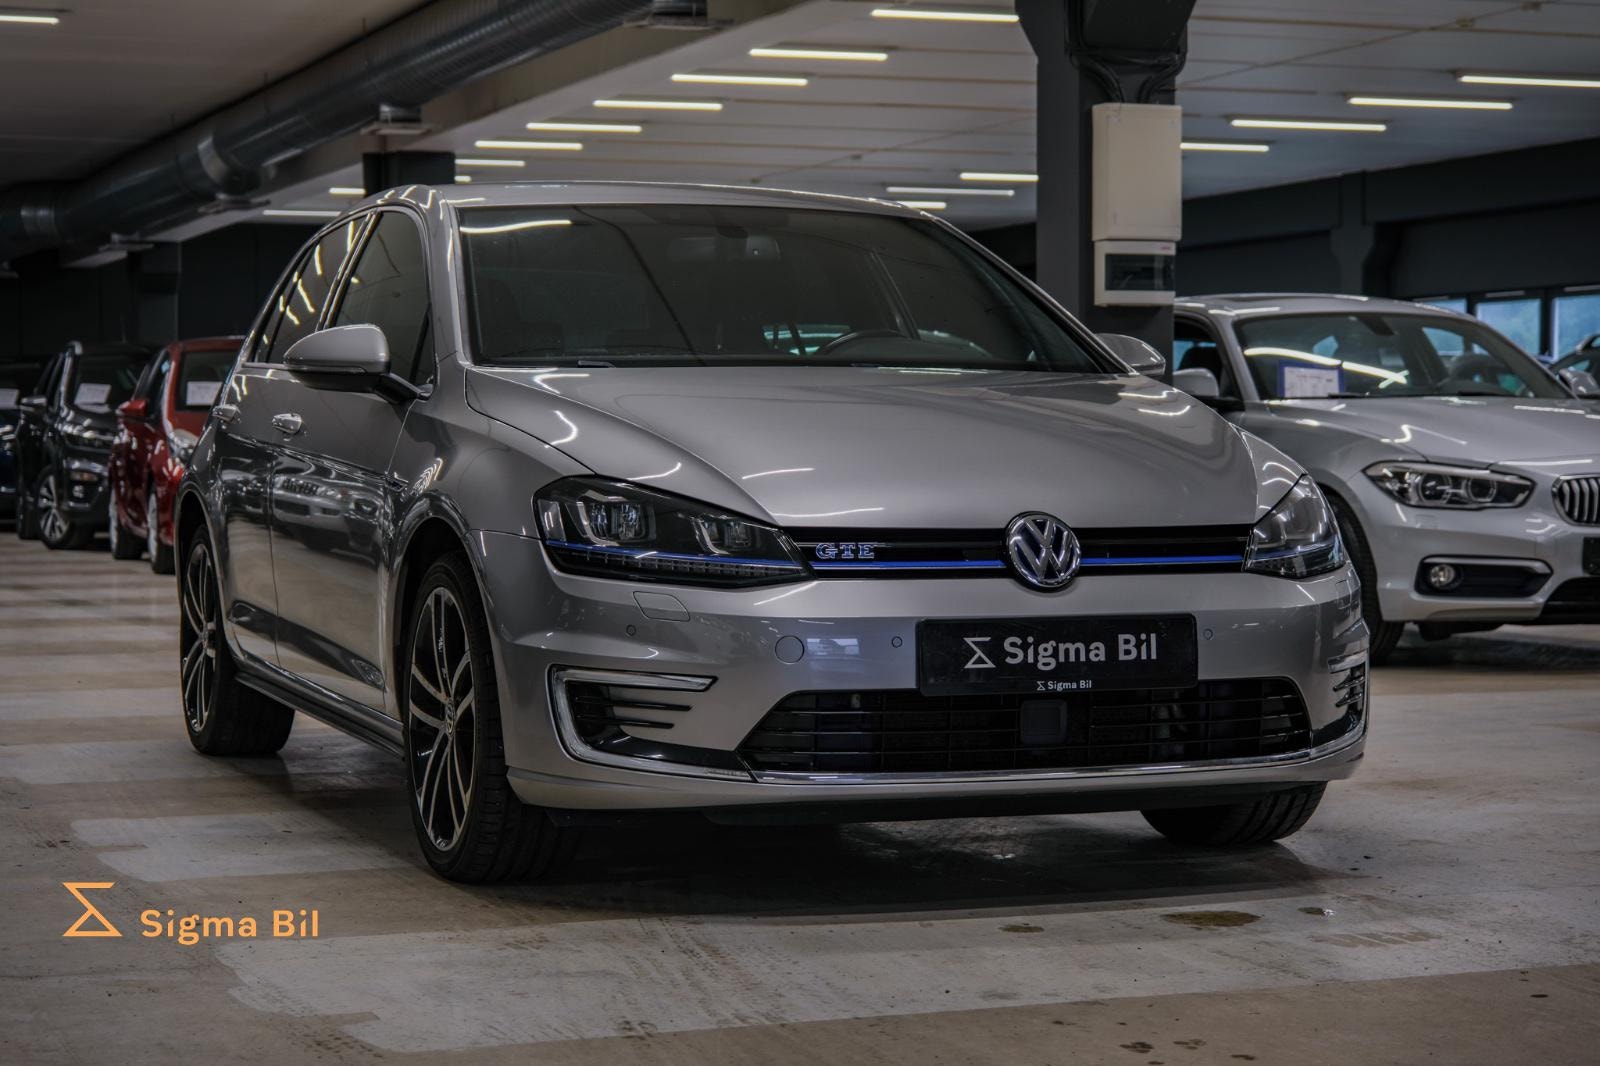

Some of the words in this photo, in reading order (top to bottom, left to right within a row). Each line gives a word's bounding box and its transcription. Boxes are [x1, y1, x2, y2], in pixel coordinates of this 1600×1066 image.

[815, 542, 876, 560] GTE
[1003, 635, 1106, 671] Sigma
[1117, 632, 1158, 662] Bil
[1047, 680, 1077, 691] Sigma
[1080, 679, 1092, 690] Bil
